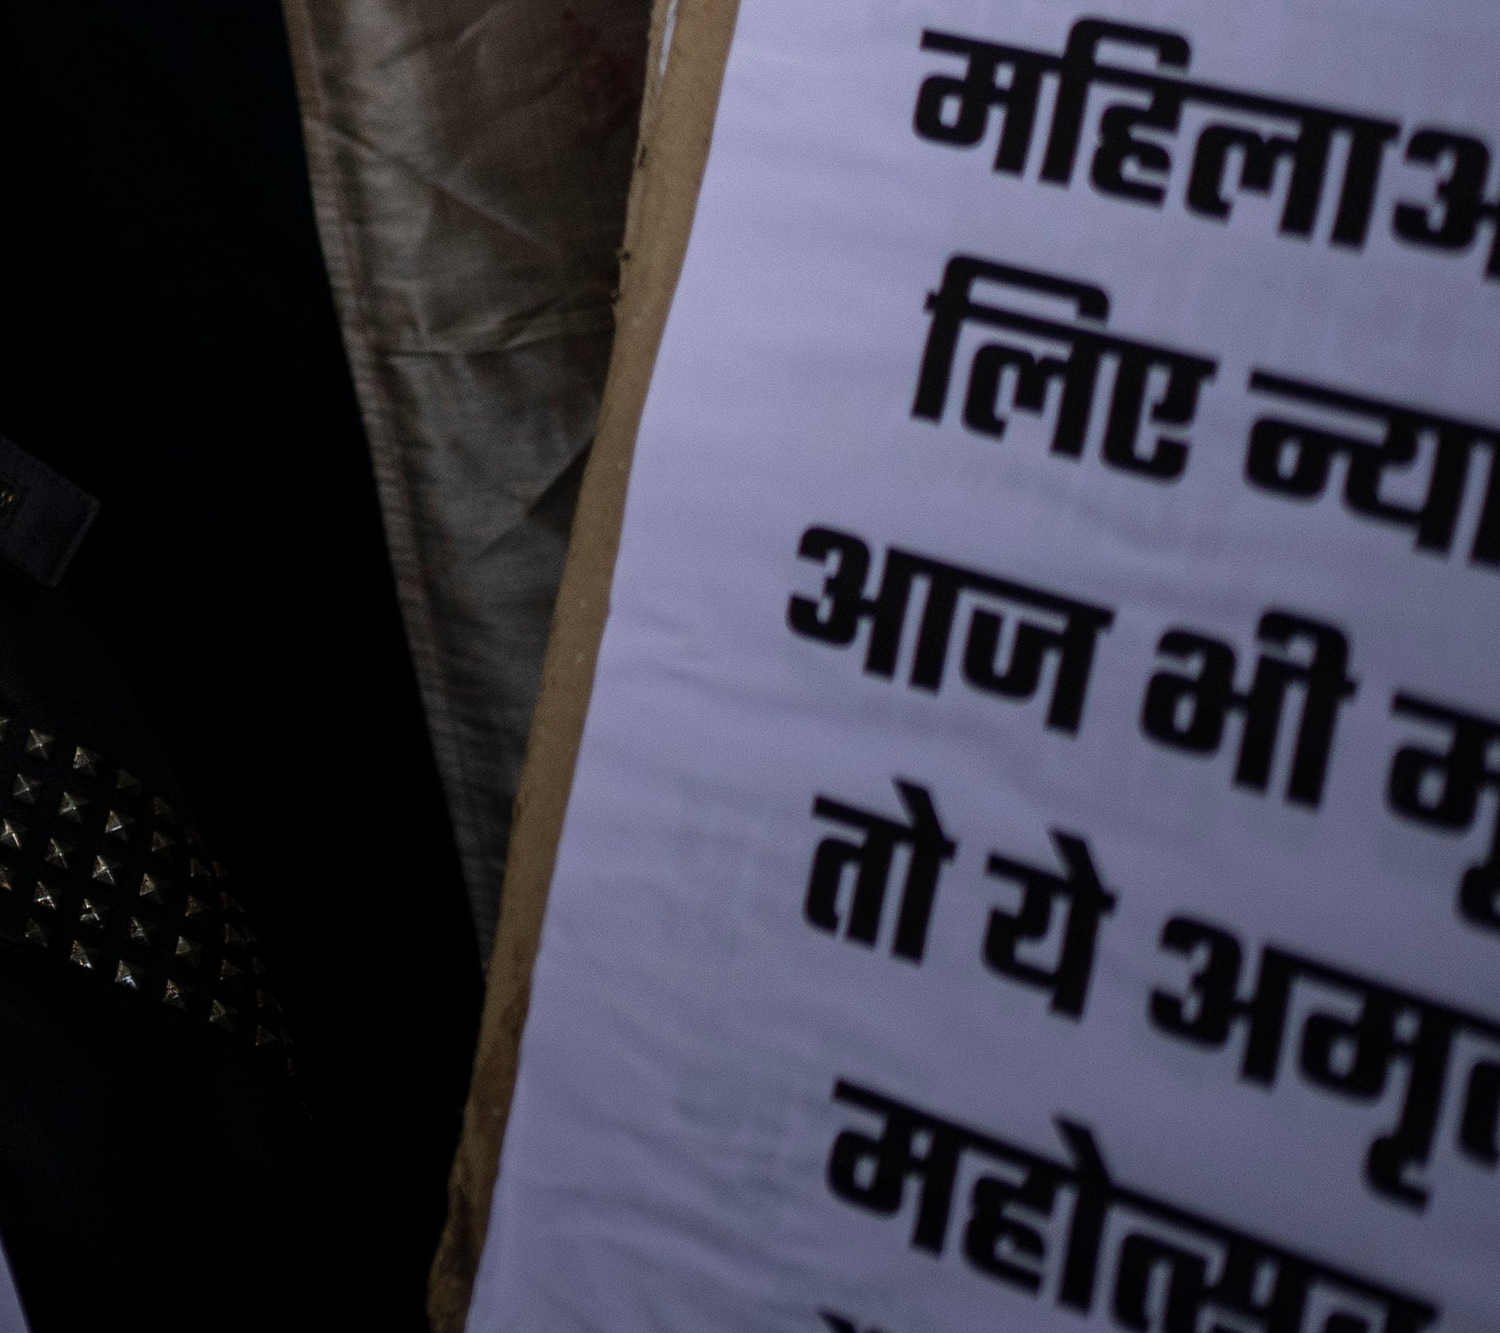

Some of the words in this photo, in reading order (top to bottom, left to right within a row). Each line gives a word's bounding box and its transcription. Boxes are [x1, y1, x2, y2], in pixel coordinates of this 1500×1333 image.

[912, 255, 1218, 482] लिए
[788, 527, 1115, 736] आज
[1141, 610, 1357, 809] भी
[804, 780, 957, 964] तो
[983, 831, 1117, 1020] ये
